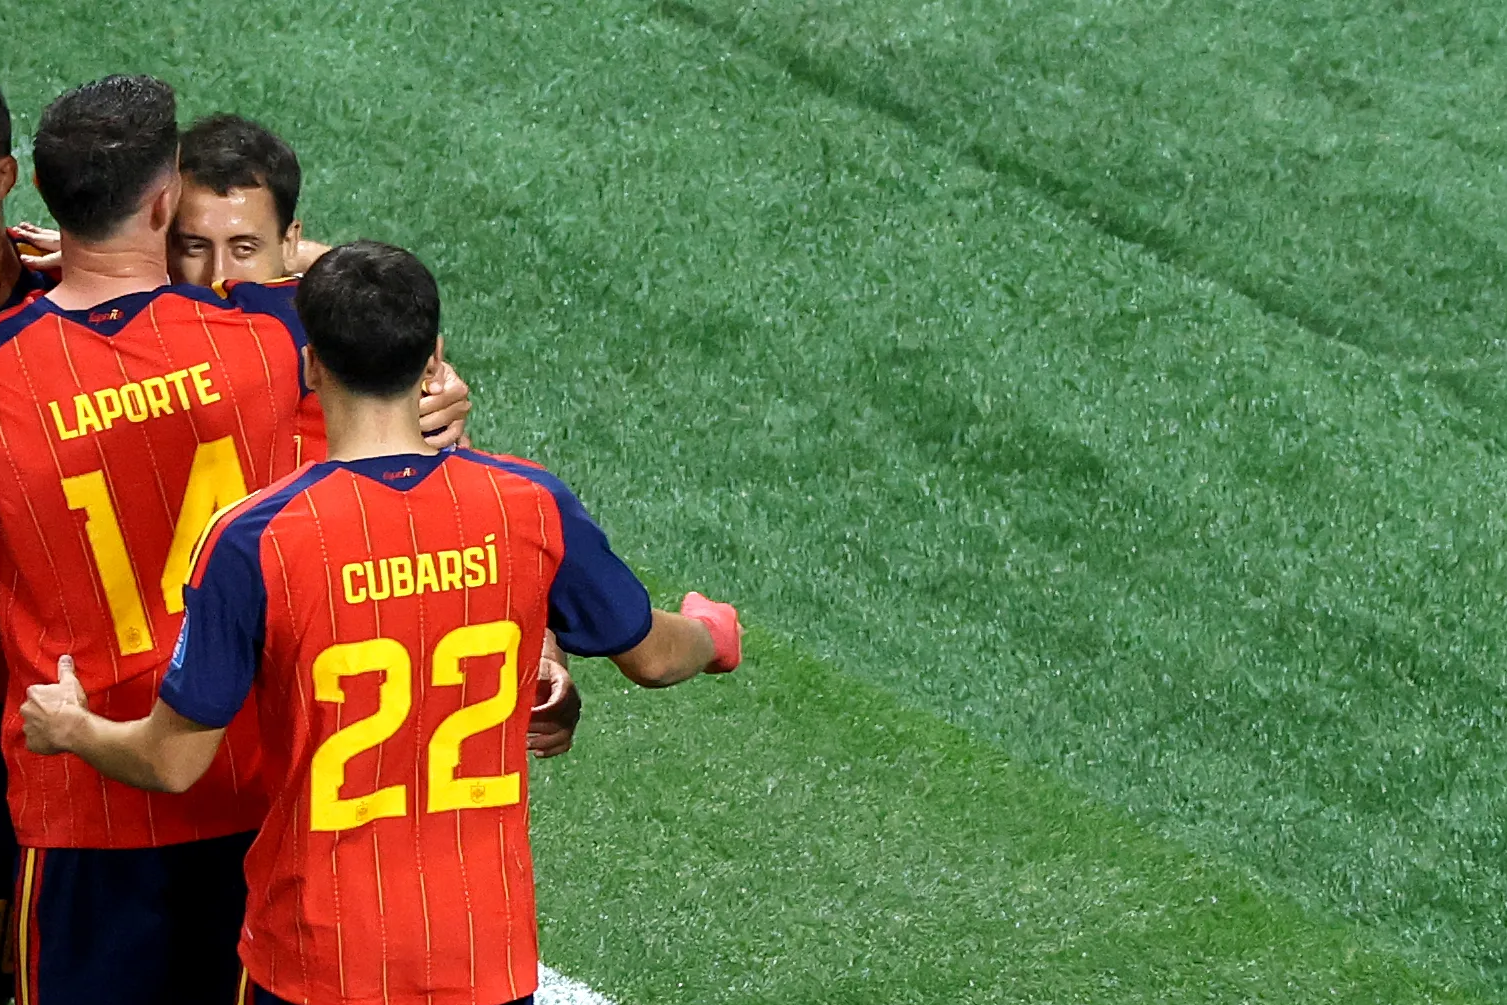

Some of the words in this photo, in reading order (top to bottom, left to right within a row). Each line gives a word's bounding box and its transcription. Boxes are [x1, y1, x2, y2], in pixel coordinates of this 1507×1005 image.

[48, 361, 222, 442] LAPORTE
[61, 434, 249, 657] 14
[342, 533, 499, 604] CUBARSÍ
[310, 620, 522, 832] 22
